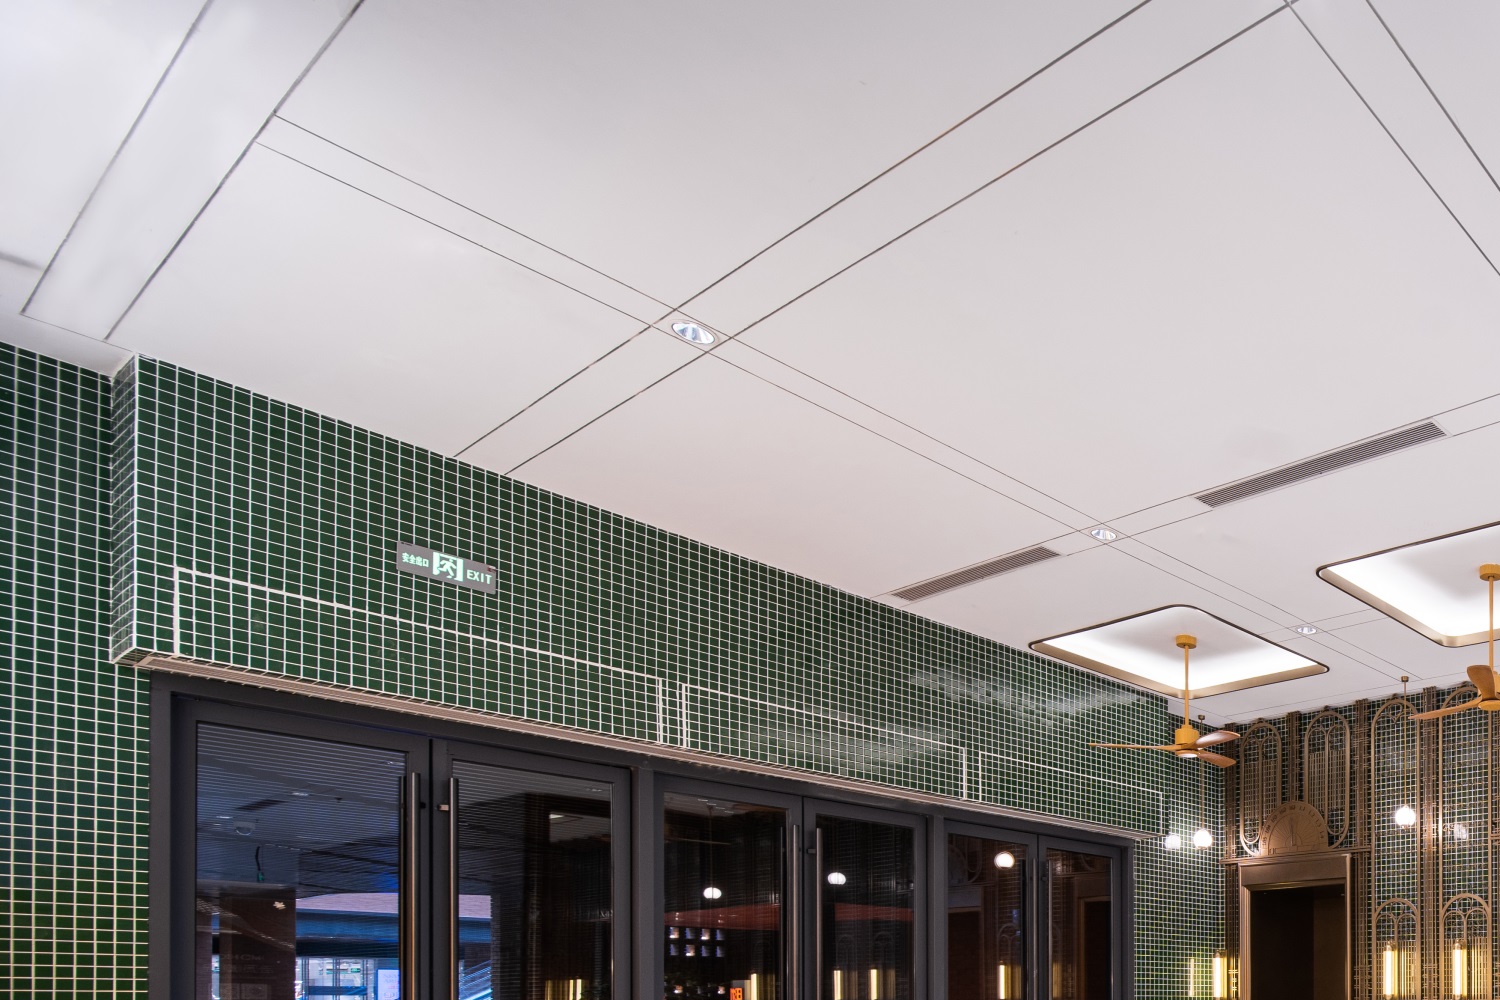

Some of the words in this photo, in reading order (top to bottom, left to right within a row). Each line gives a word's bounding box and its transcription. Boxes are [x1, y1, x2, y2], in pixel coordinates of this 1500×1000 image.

[401, 551, 430, 568] 安全出口
[466, 569, 493, 585] EXIT
